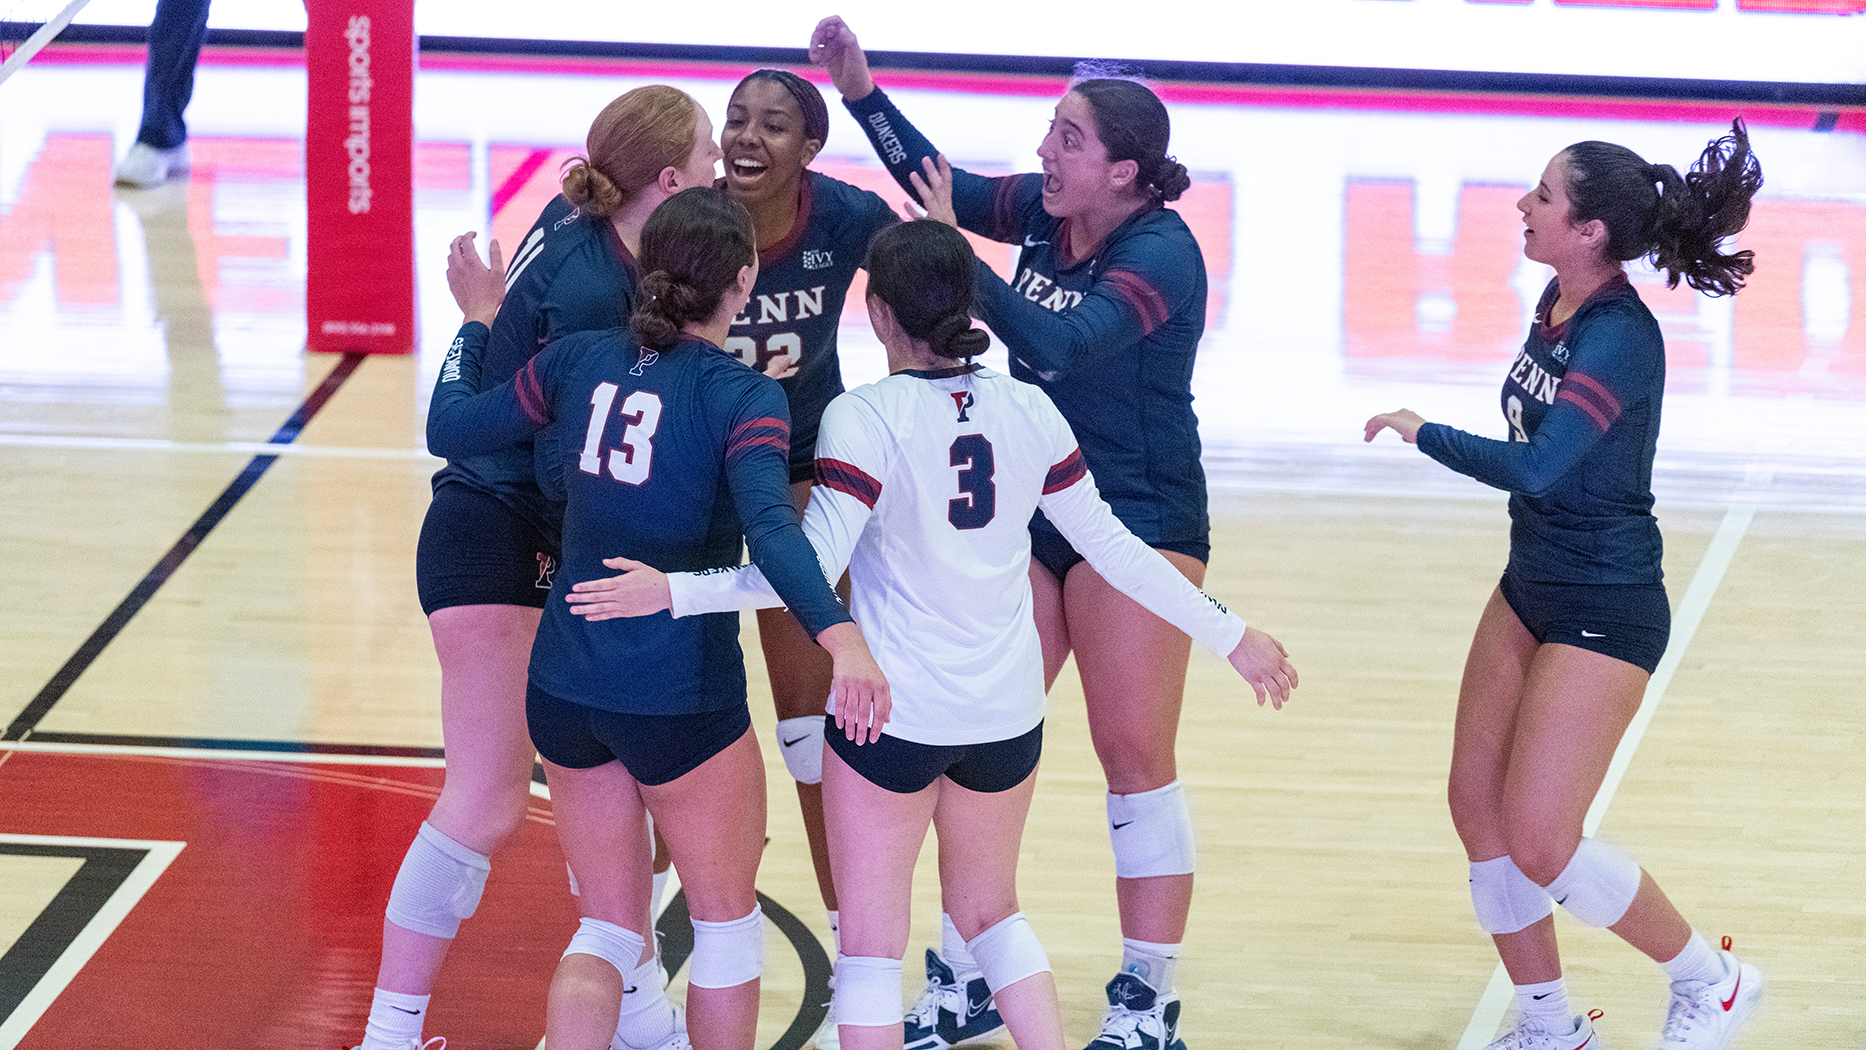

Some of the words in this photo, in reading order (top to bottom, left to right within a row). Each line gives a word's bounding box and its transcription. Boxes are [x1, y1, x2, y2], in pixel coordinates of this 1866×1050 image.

[345, 14, 374, 104] sports
[343, 105, 373, 214] imports
[869, 111, 908, 165] QUAKERS
[810, 251, 833, 265] IVY
[579, 381, 663, 486] 13
[950, 391, 975, 423] P
[948, 433, 996, 531] 3
